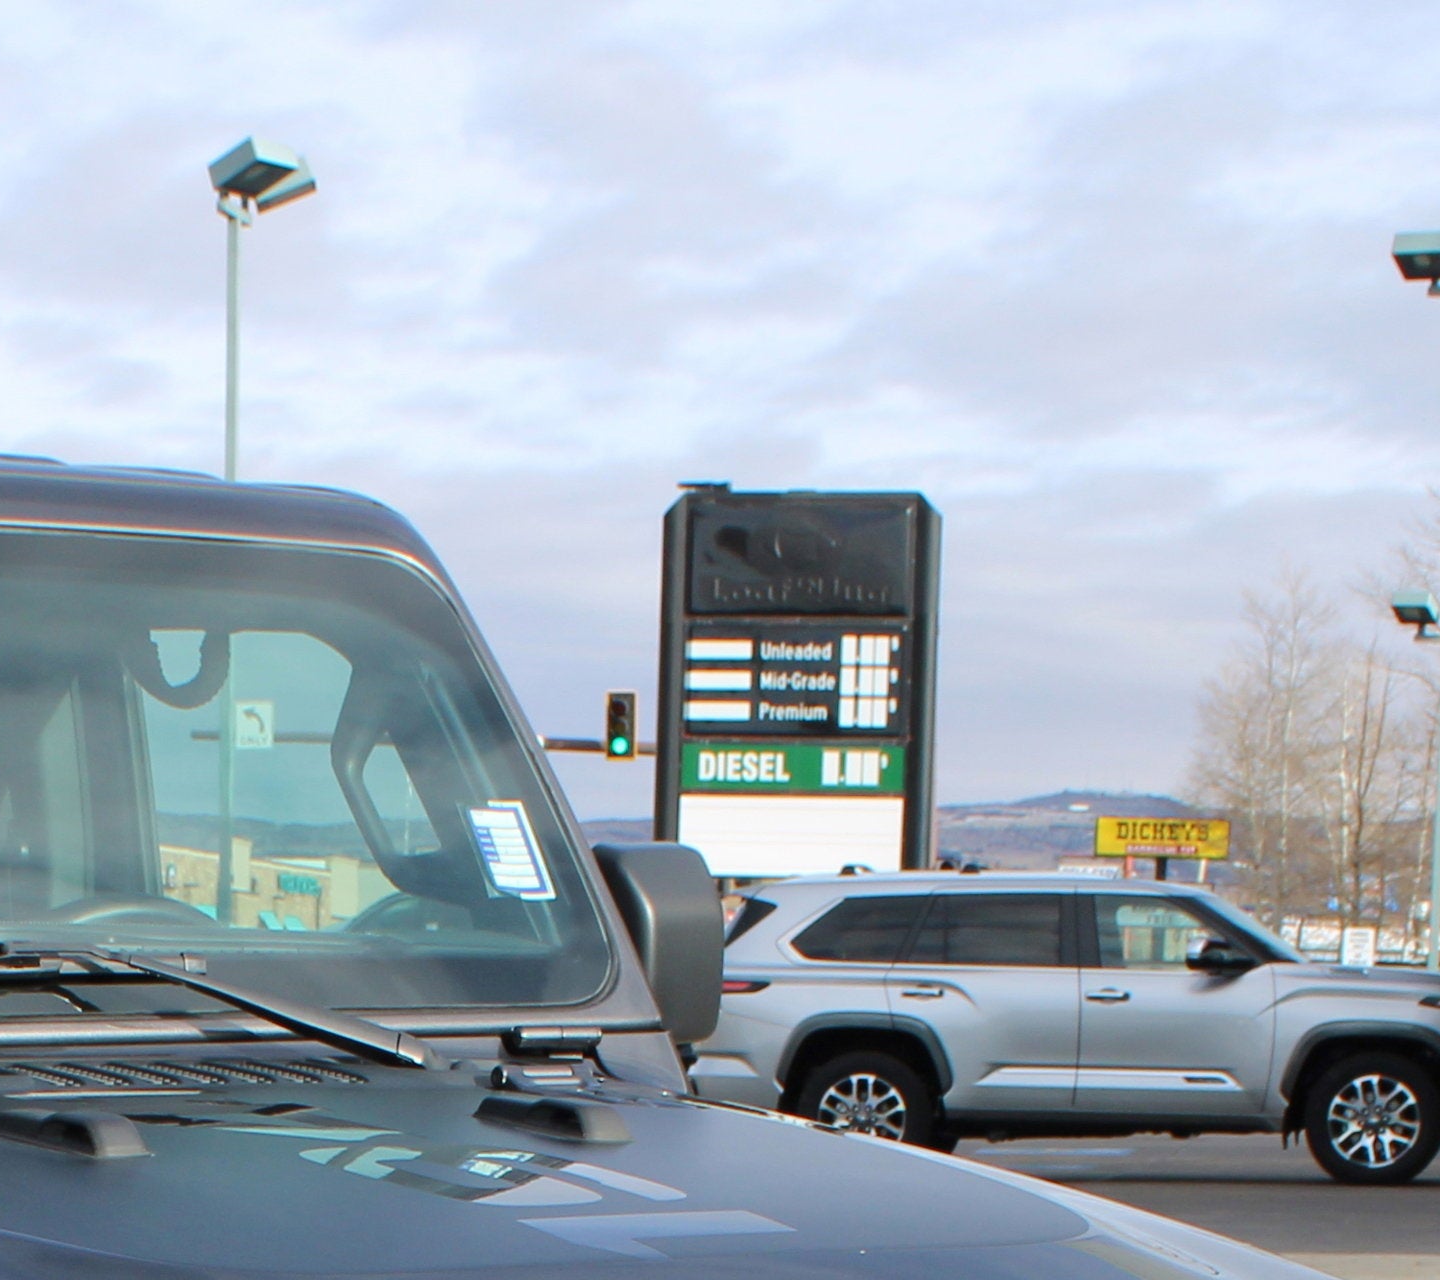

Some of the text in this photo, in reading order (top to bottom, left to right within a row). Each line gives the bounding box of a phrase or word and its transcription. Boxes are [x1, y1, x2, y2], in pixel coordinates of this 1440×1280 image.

[760, 642, 832, 661] Unleaded
[760, 671, 836, 691] Mid-Grade
[758, 702, 828, 721] Premium
[698, 750, 791, 782] DIESEL
